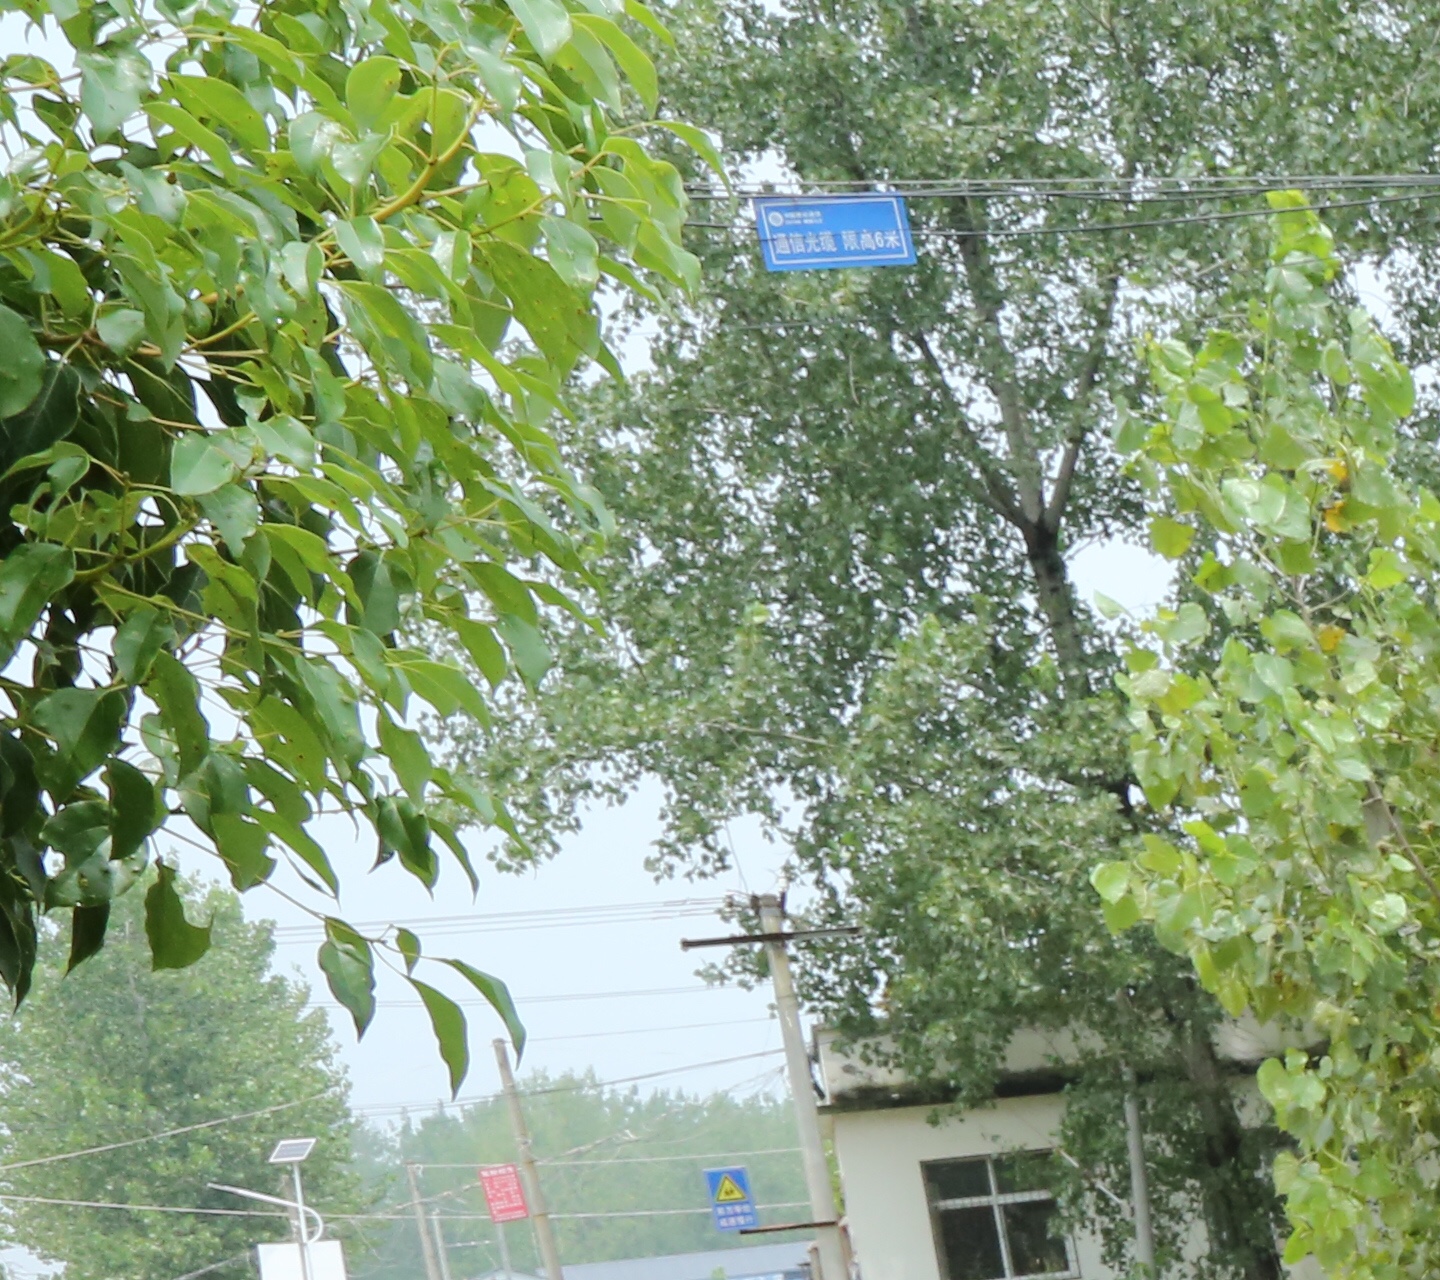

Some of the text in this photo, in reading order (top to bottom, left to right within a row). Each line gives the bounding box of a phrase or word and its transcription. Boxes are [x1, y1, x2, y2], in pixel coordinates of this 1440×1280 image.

[773, 230, 901, 255] 通信光缆 限高6米
